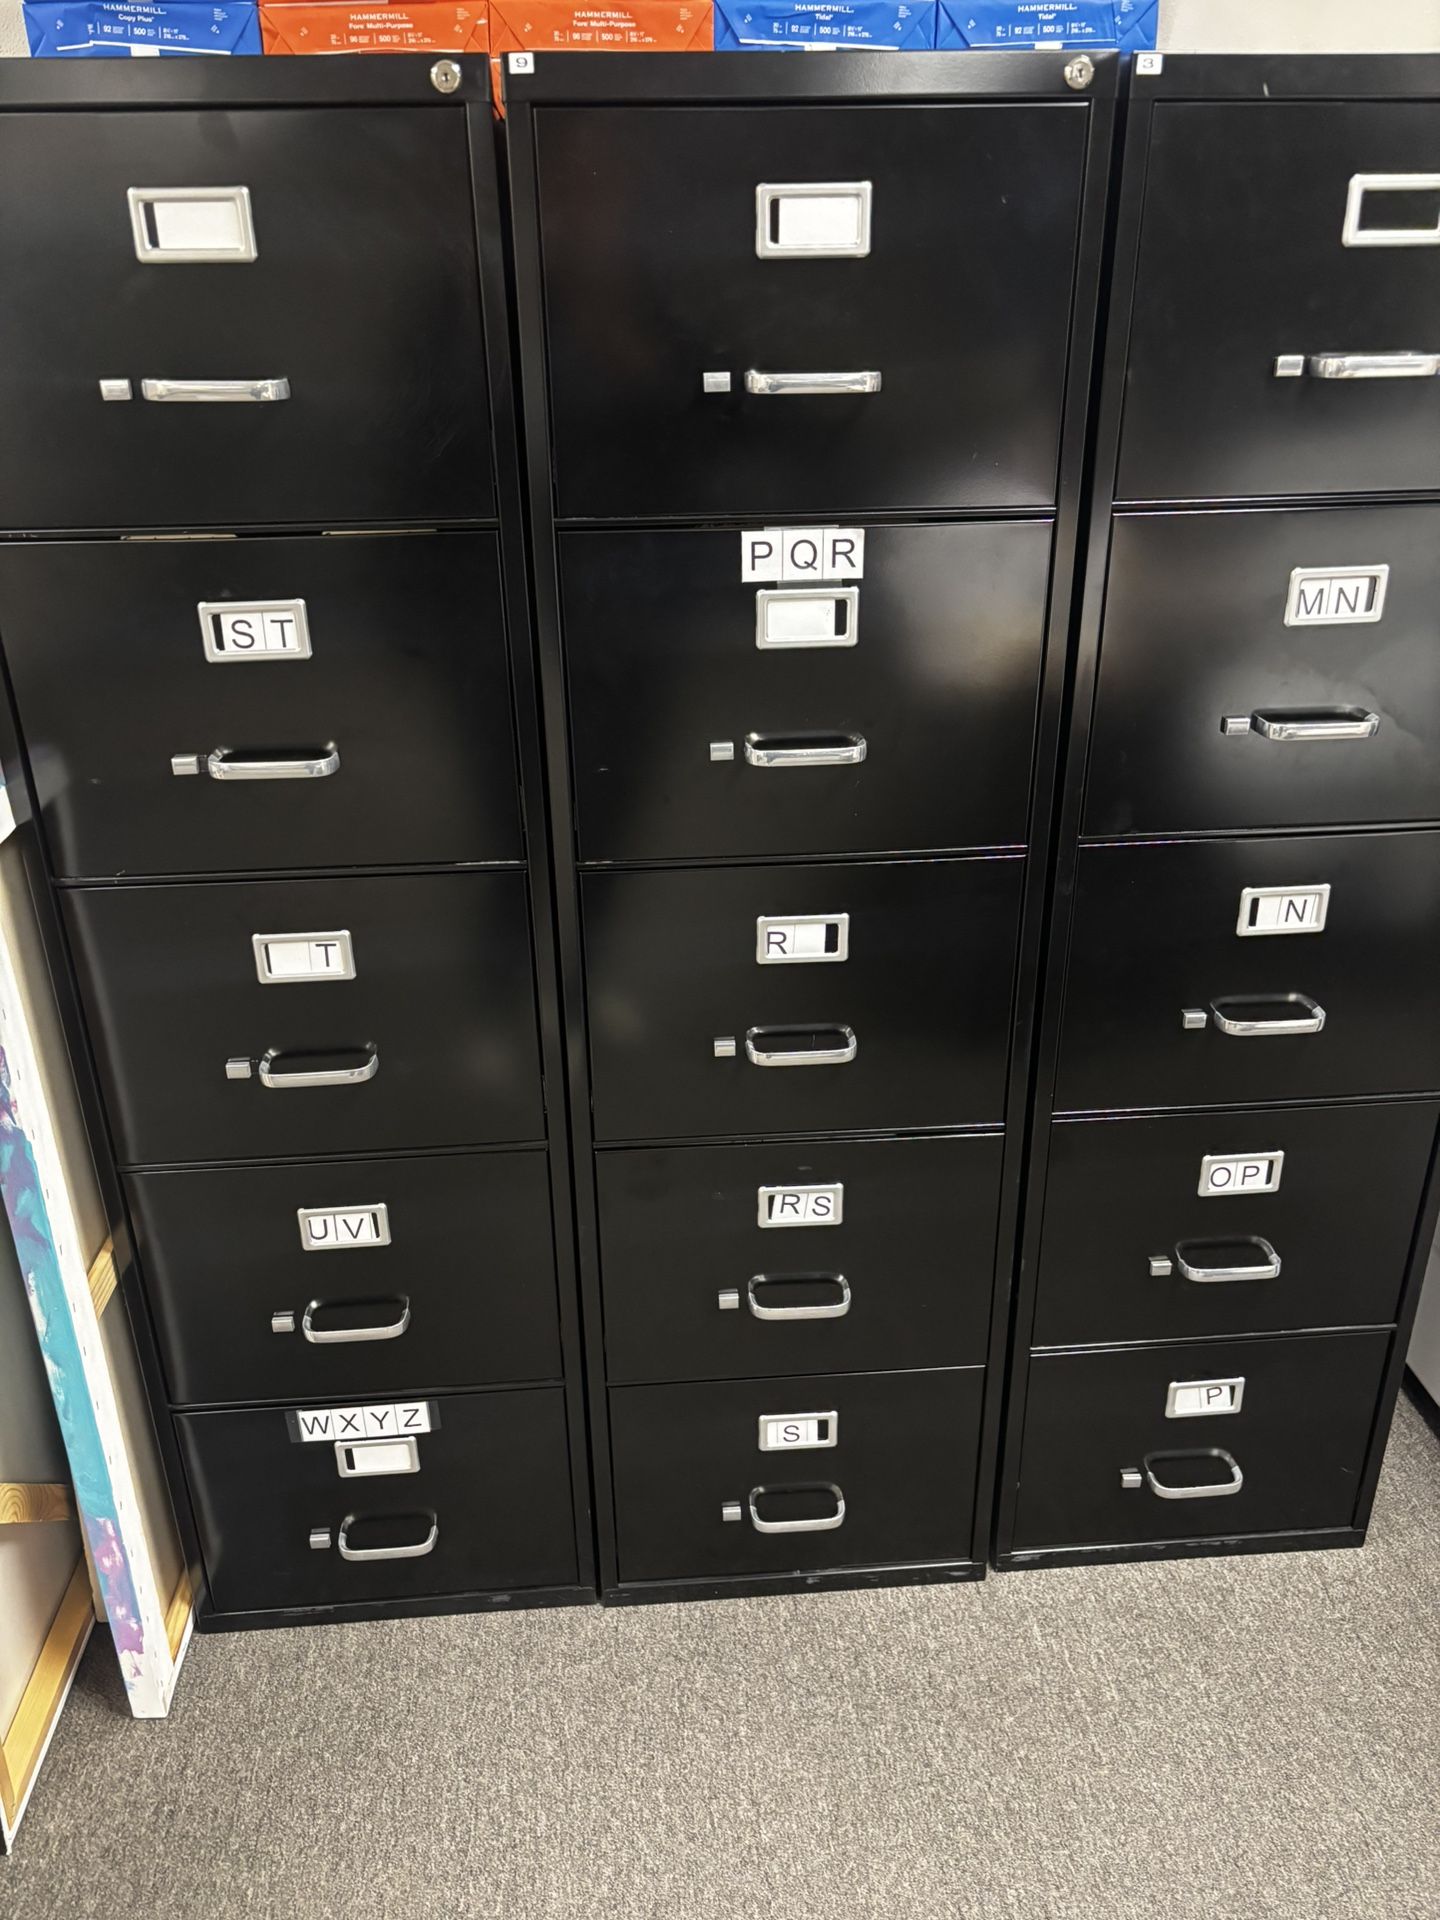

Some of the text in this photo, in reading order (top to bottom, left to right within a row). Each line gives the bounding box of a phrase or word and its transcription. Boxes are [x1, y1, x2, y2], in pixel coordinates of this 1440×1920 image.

[103, 4, 165, 14] HAMMERMILL
[795, 4, 852, 13] HAMMERMILL
[1018, 4, 1075, 12] HAMMERMILL
[118, 14, 135, 22] Copy
[516, 57, 528, 68] 9
[1142, 58, 1154, 69] 3
[1284, 899, 1308, 922] N
[767, 931, 787, 954] R
[315, 943, 337, 967] T
[1206, 1386, 1223, 1405] P
[783, 1425, 800, 1442] S
